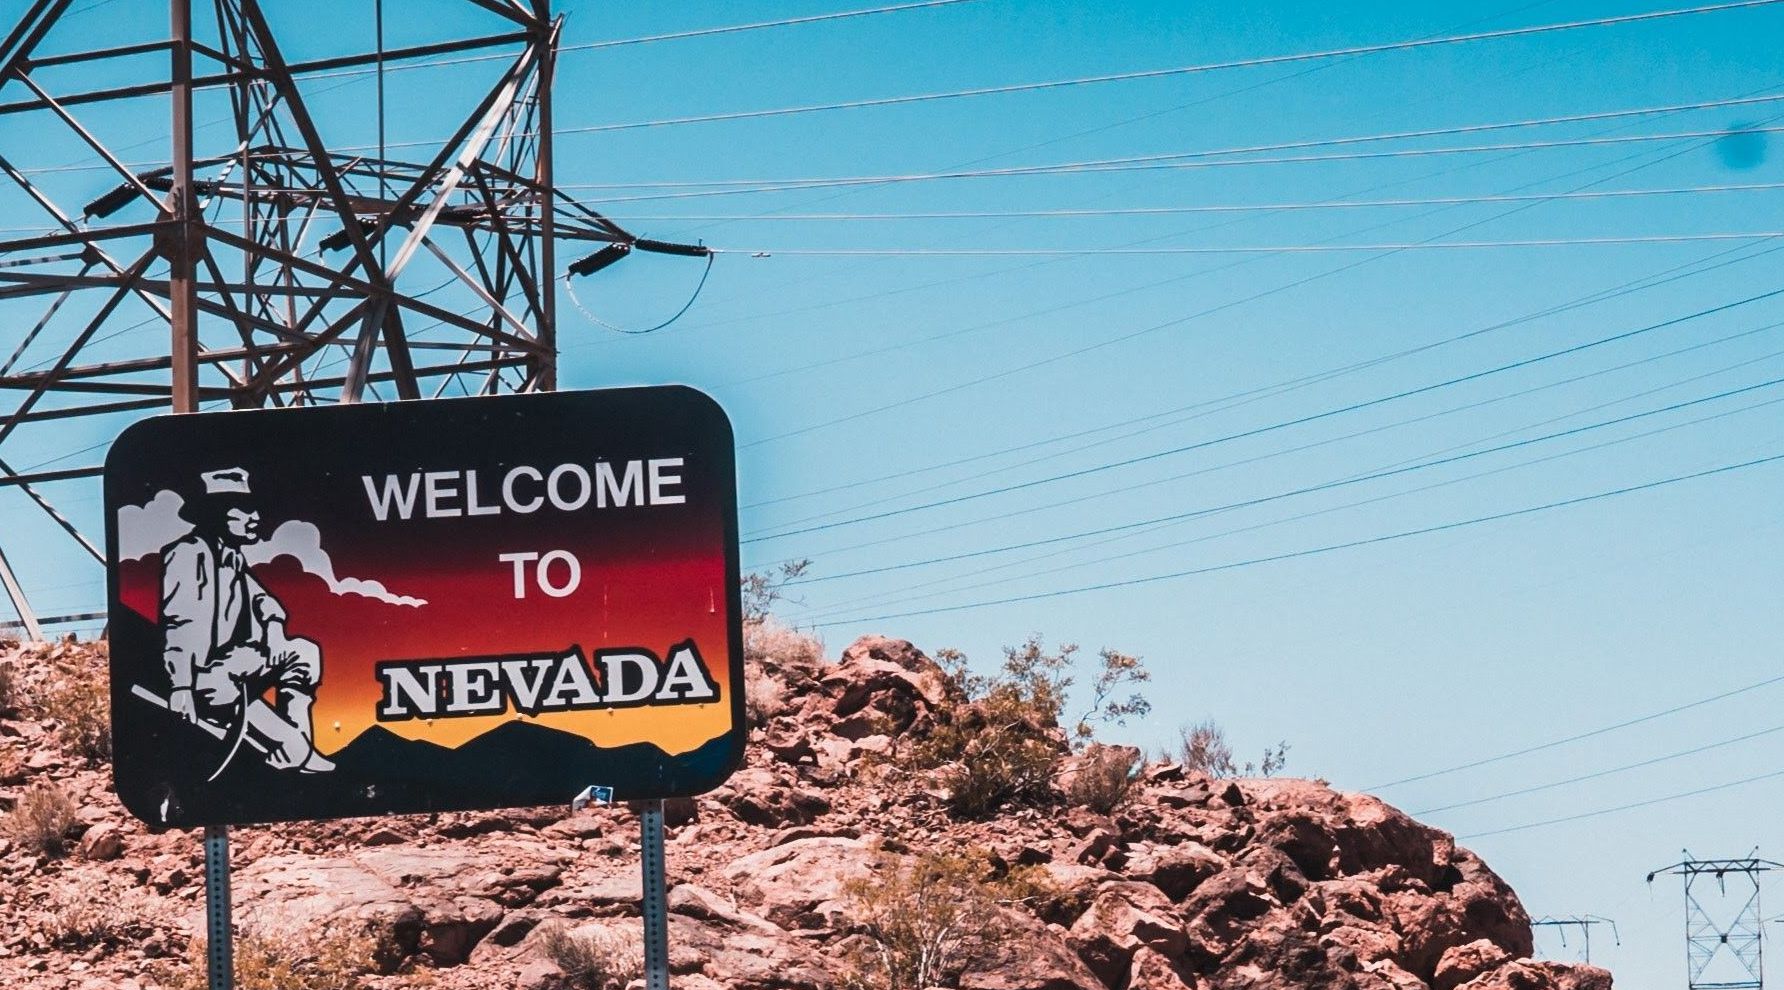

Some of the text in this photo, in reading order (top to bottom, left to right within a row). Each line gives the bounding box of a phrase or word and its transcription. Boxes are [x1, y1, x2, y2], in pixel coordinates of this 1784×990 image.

[361, 457, 686, 521] WELCOME
[499, 550, 582, 599] TO
[382, 647, 714, 716] NEVADA
